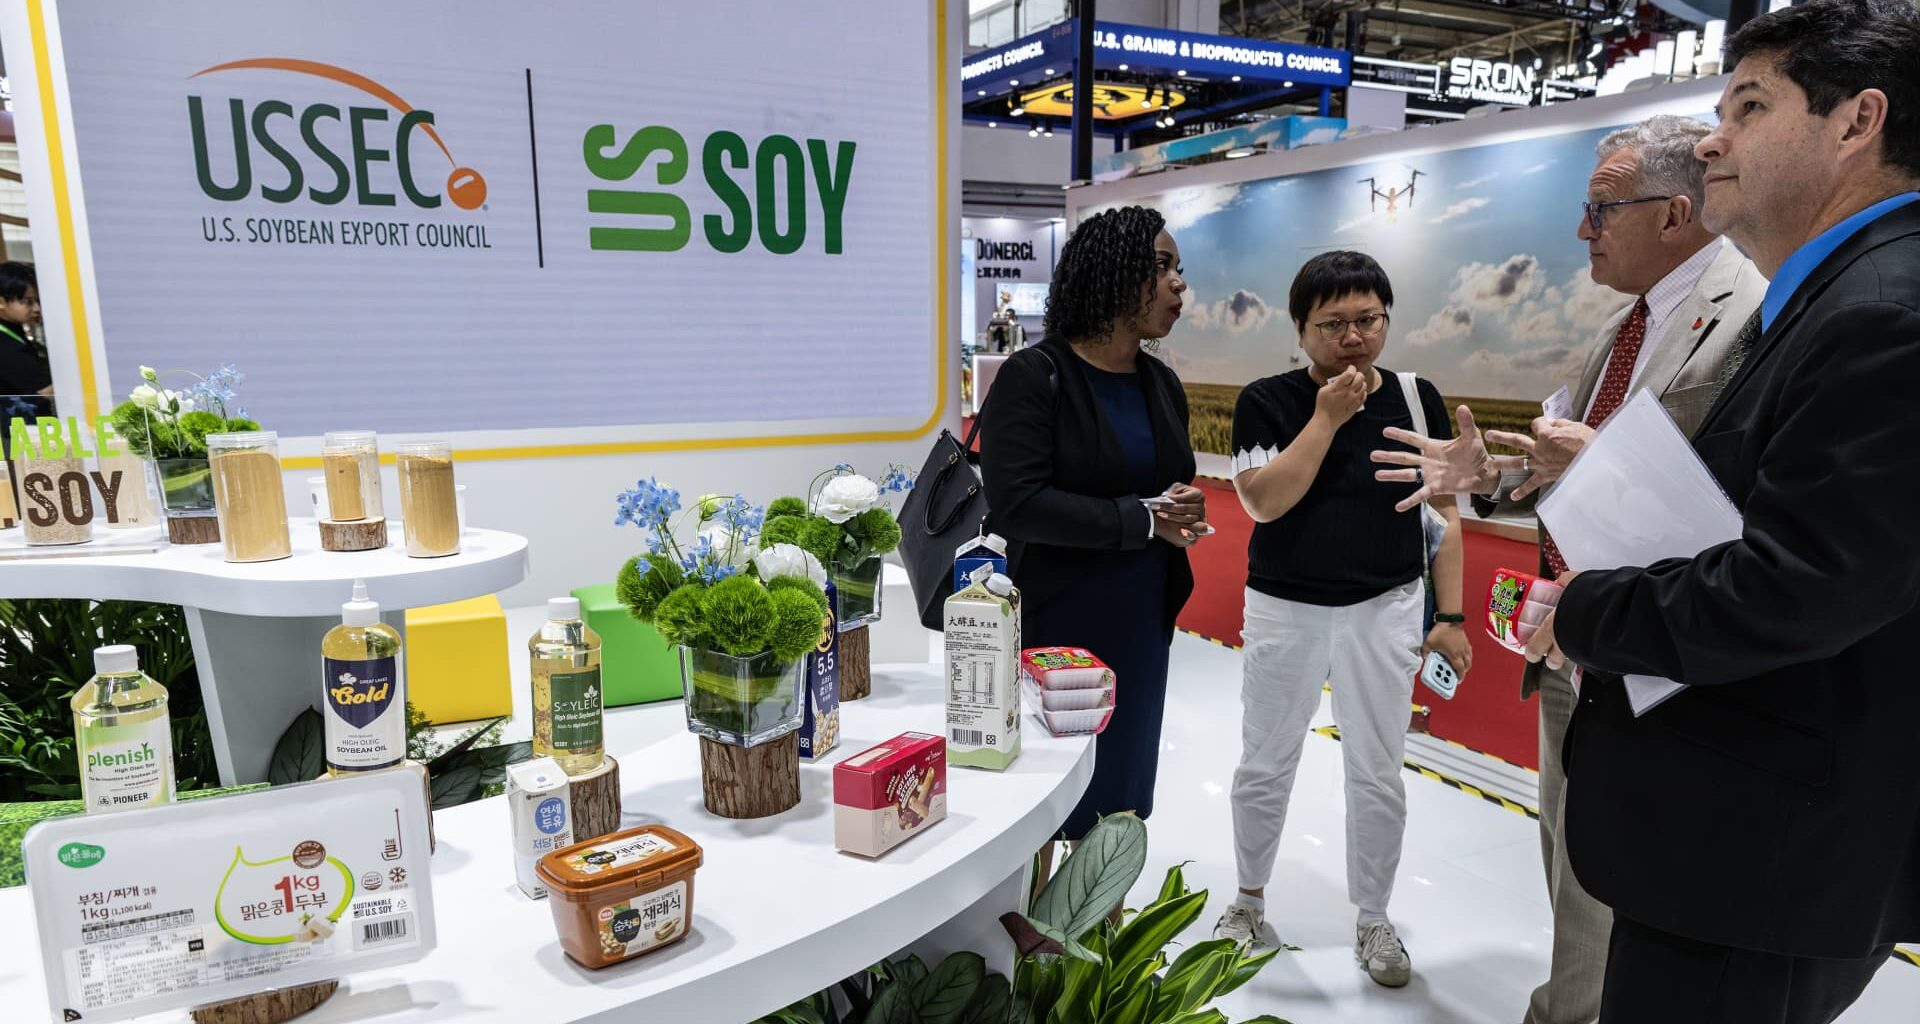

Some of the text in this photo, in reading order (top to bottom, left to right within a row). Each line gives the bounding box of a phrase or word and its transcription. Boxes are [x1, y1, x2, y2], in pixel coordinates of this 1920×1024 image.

[1004, 41, 1045, 66] COUNCIL
[1094, 31, 1342, 74] U.S. GRAINS & BIOPRODUCTS COUNCIL
[1449, 57, 1535, 92] SRON
[187, 95, 442, 208] USSEC
[583, 124, 691, 252] US
[702, 130, 856, 255] SOY
[202, 216, 492, 248] U.S. SOYBEAN EXPORT COUNCIL
[0, 416, 121, 461] ABLE
[24, 471, 123, 527] SOY
[818, 652, 833, 676] 5.5
[331, 683, 388, 705] Gold
[88, 742, 154, 771] plenish
[113, 792, 148, 804] PIONEER
[540, 804, 561, 817] 연세
[542, 816, 562, 829] 두유
[135, 902, 152, 912] kcal)
[296, 892, 328, 910] 두부
[353, 899, 392, 910] SUSTAINABLE
[365, 905, 392, 916] U.S. SOY
[642, 894, 680, 920] 재래식
